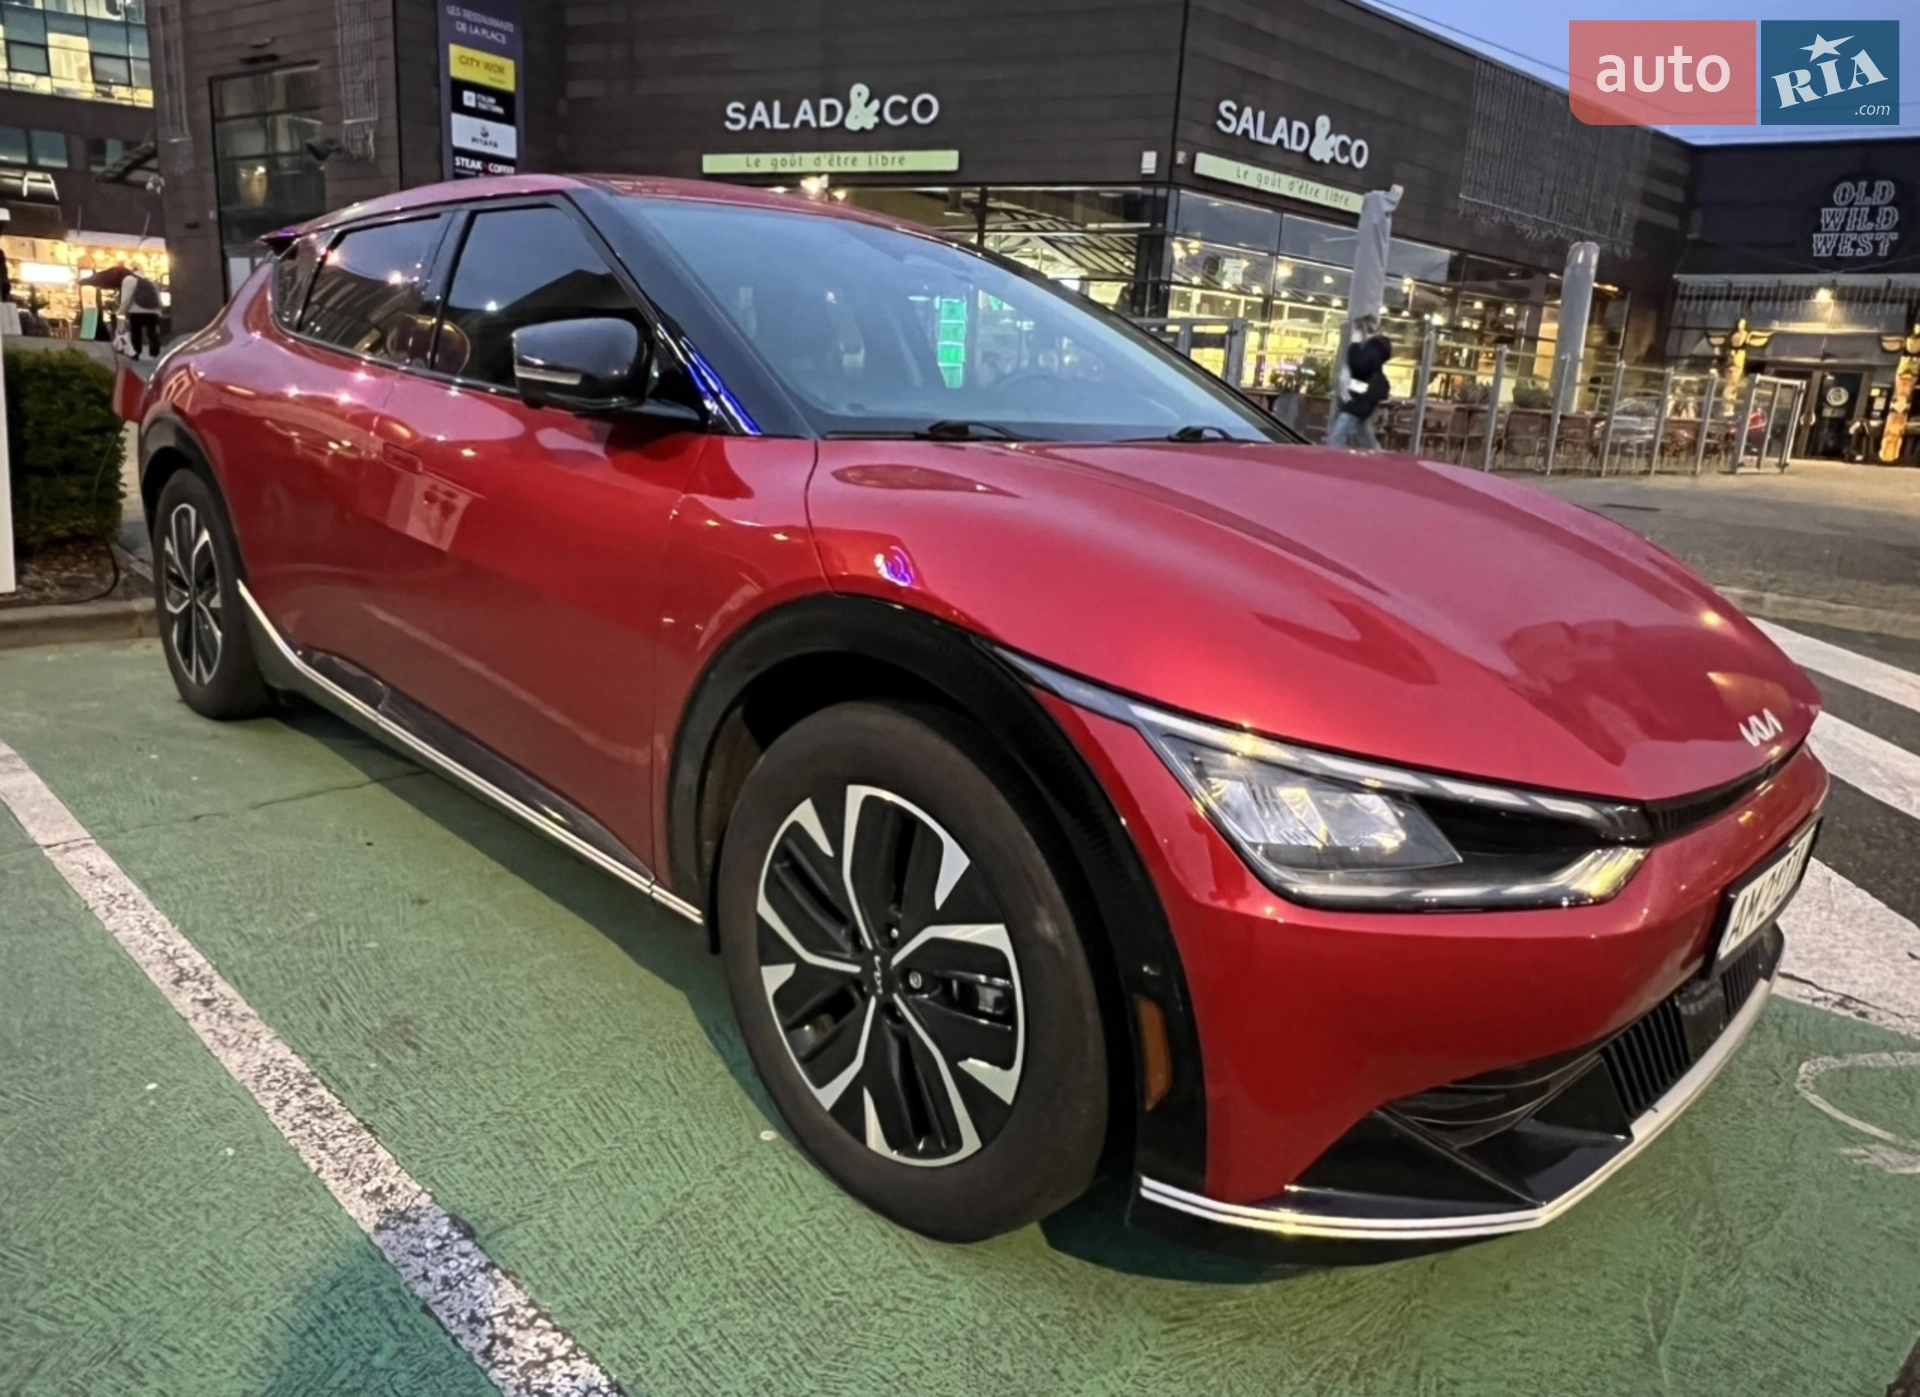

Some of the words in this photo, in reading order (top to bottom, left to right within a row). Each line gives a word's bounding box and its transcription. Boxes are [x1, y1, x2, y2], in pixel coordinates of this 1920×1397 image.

[469, 24, 480, 36] LA
[459, 54, 481, 68] CITY
[724, 83, 940, 131] SALAD&CO
[1216, 99, 1369, 169] SALAD&CO
[454, 156, 483, 171] STEAK
[745, 156, 761, 168] Le
[770, 154, 803, 172] goût
[1833, 180, 1895, 206] OLD
[1821, 206, 1899, 231] WILD
[1812, 232, 1899, 257] WEST
